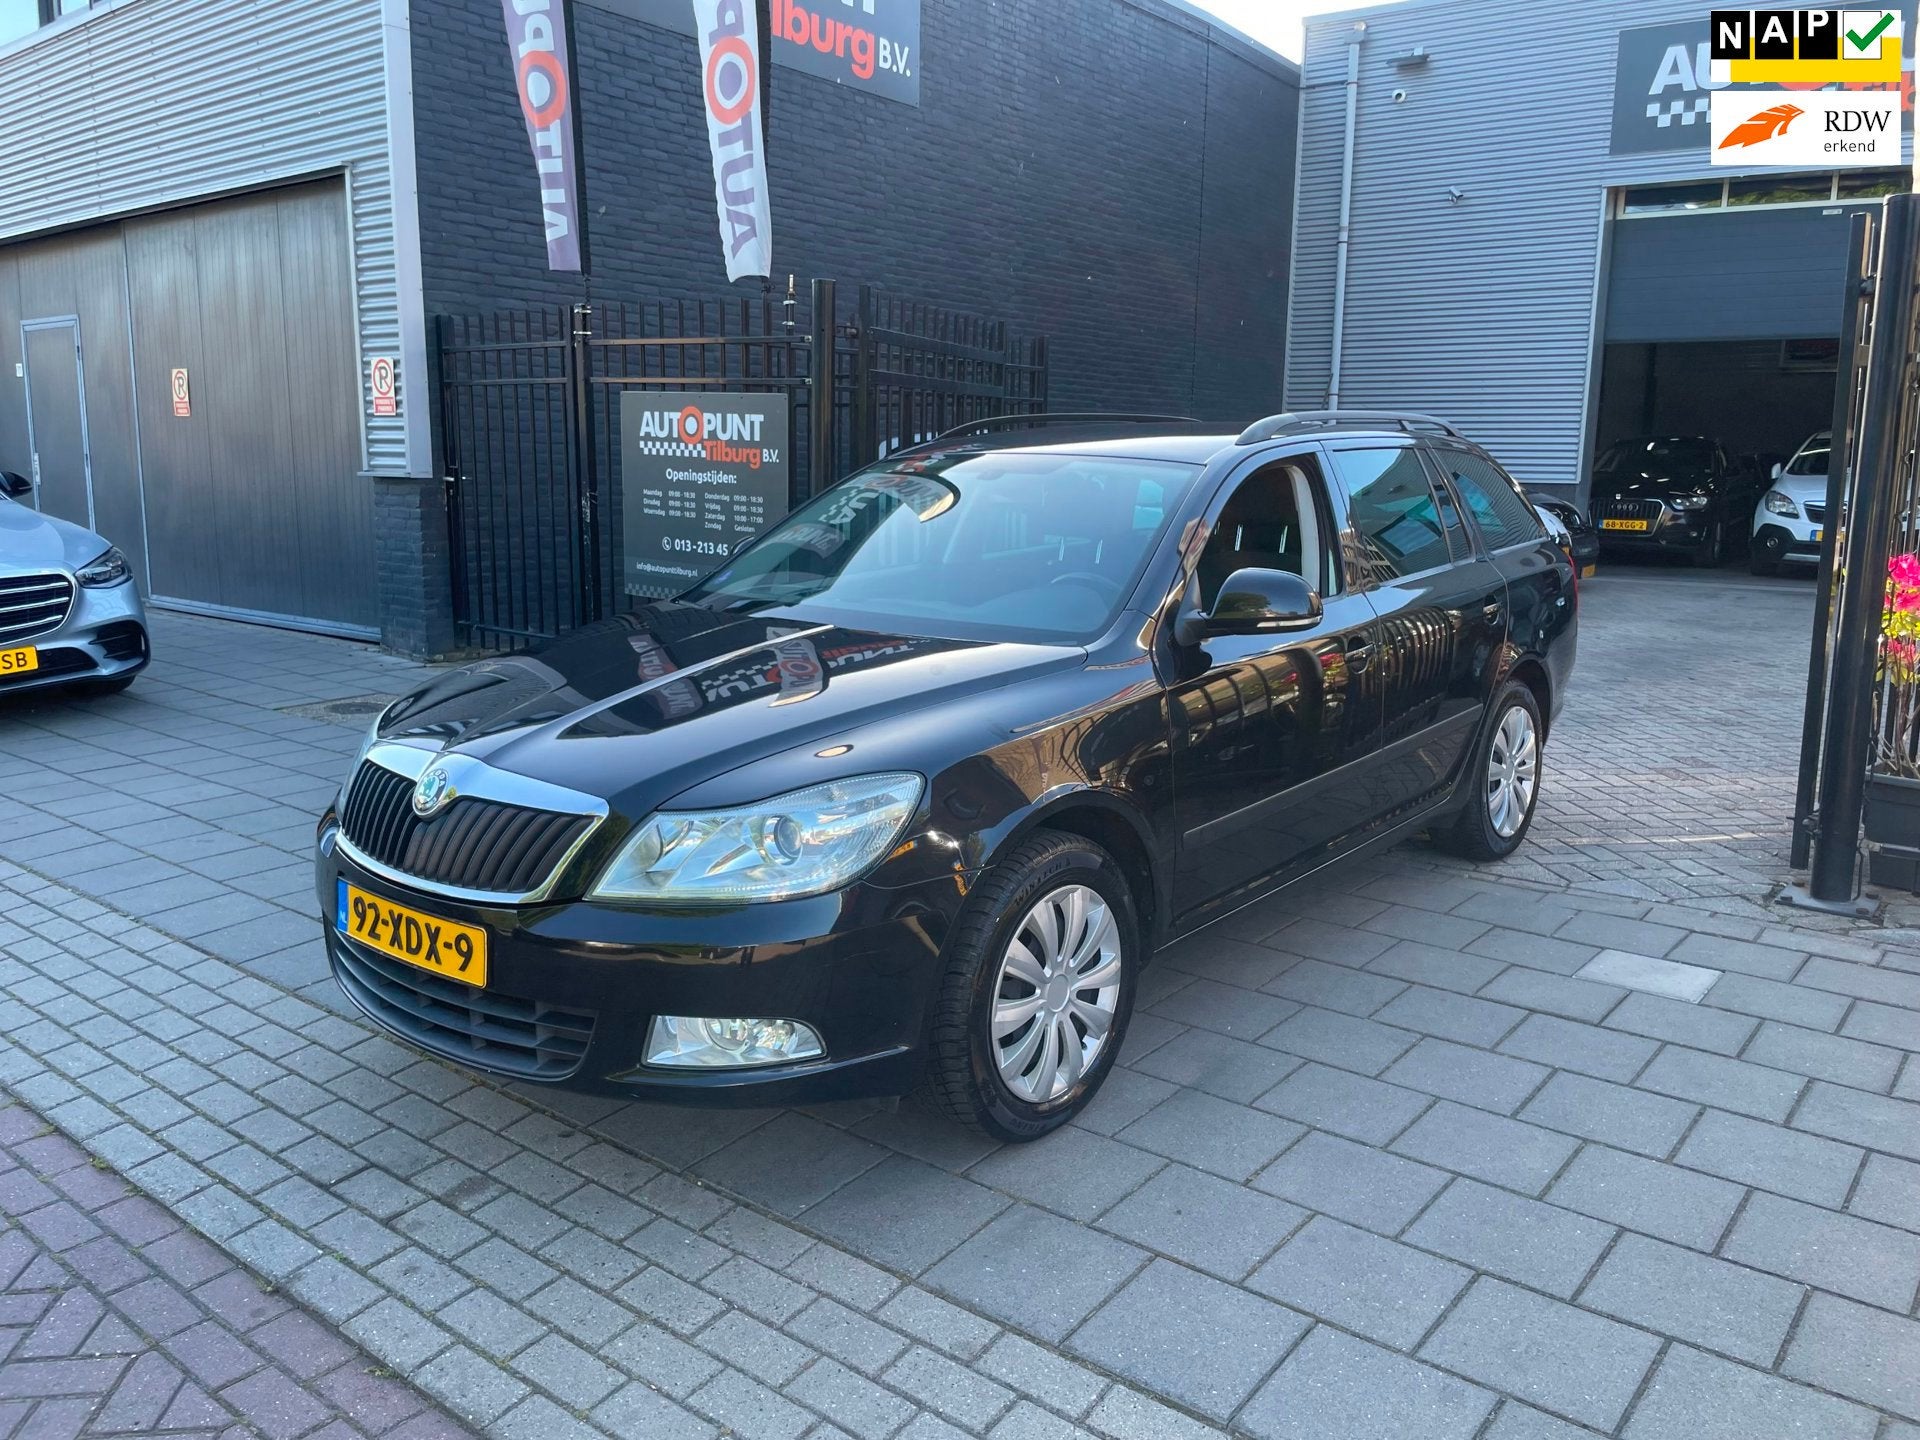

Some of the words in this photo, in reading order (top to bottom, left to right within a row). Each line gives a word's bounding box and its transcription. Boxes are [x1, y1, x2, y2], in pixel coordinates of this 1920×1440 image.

[879, 36, 911, 77] B.V.
[639, 405, 764, 445] AUTOPUNT
[703, 440, 761, 469] Tilburg
[762, 449, 779, 463] B.V.
[665, 468, 737, 485] Openingstijden:
[1605, 520, 1645, 529] 68-XGG-2
[353, 896, 474, 972] 92-XDX-9
